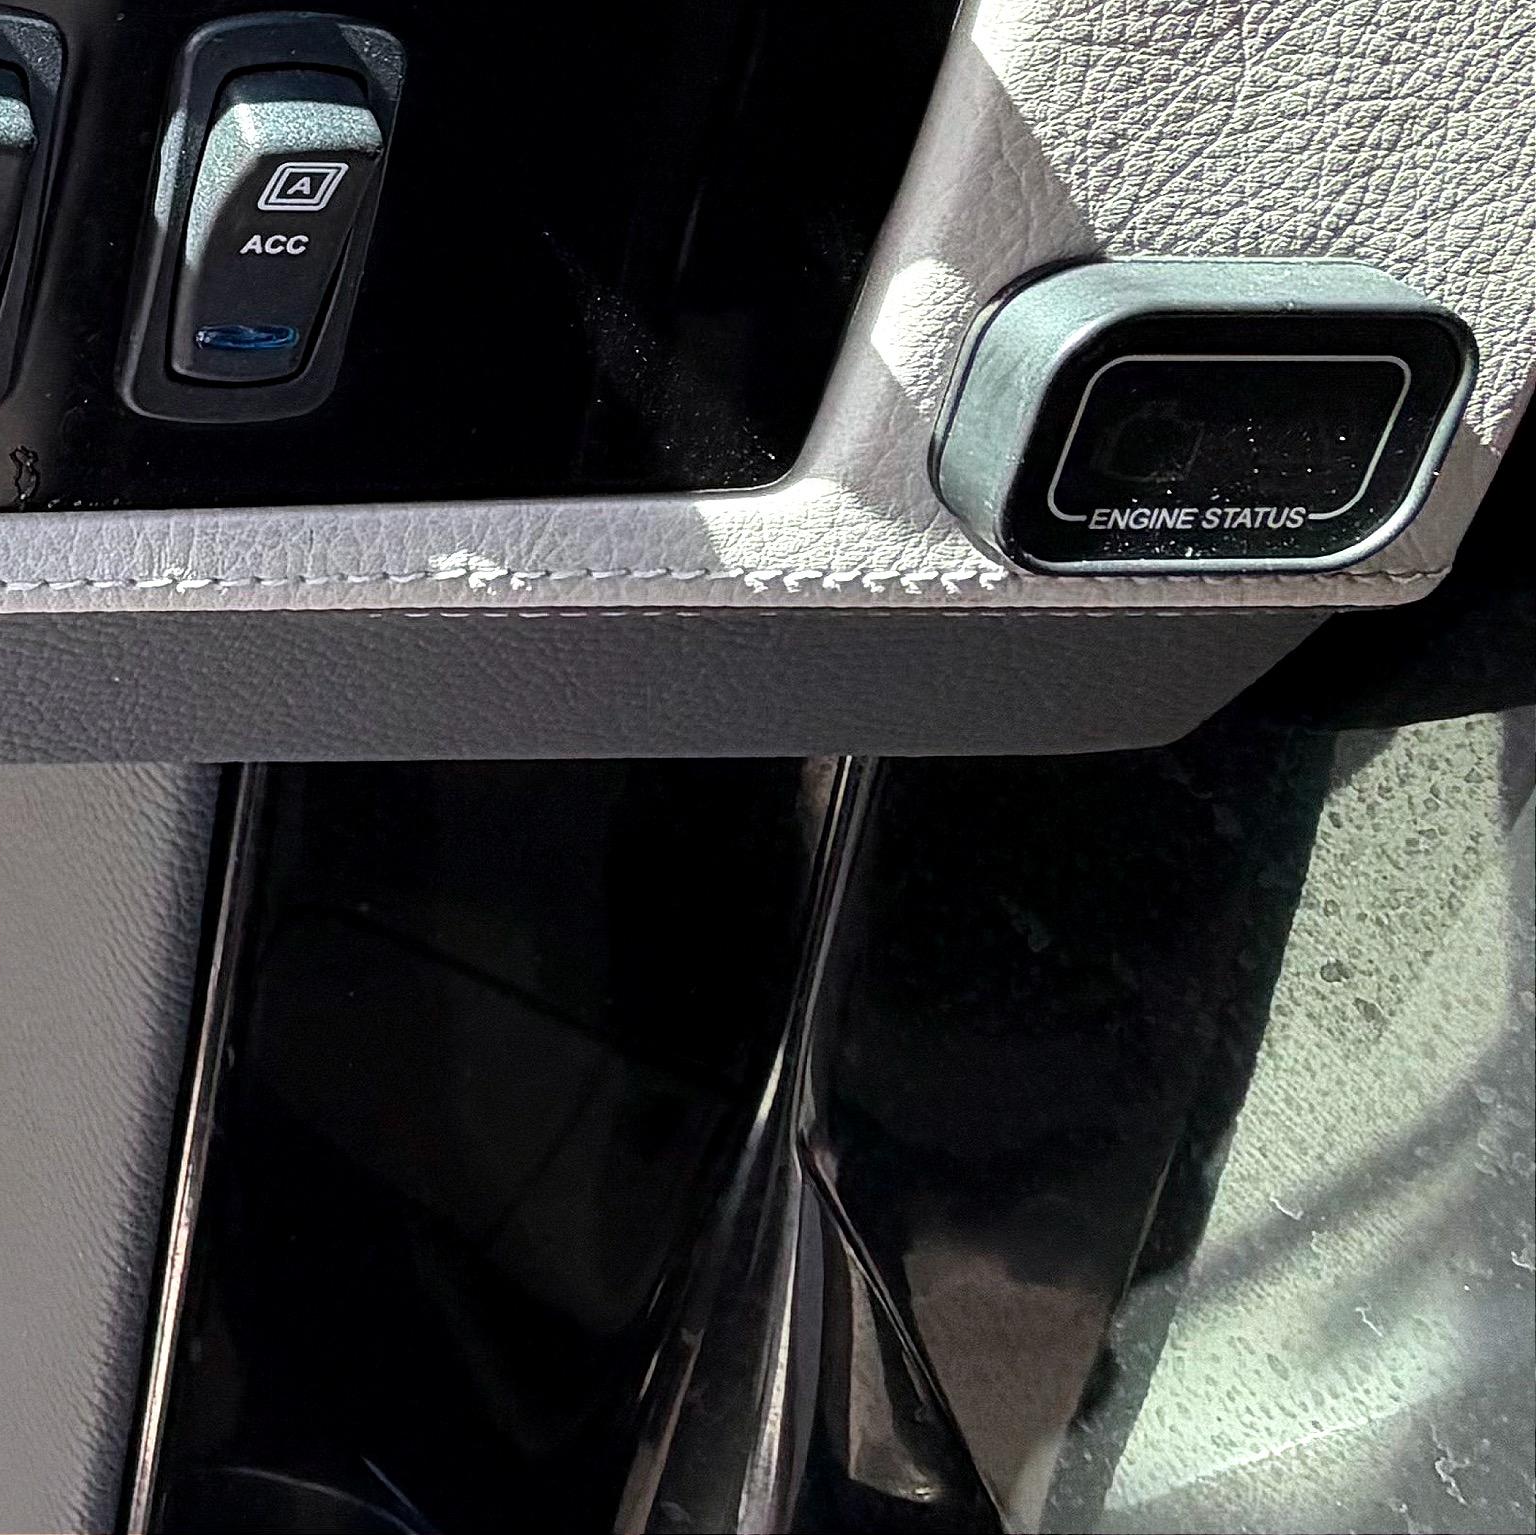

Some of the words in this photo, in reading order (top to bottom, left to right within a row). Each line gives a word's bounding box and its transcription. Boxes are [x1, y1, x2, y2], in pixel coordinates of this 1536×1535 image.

[239, 234, 309, 255] ACC
[1089, 507, 1199, 530] ENGINE
[1201, 506, 1307, 530] STATUS
